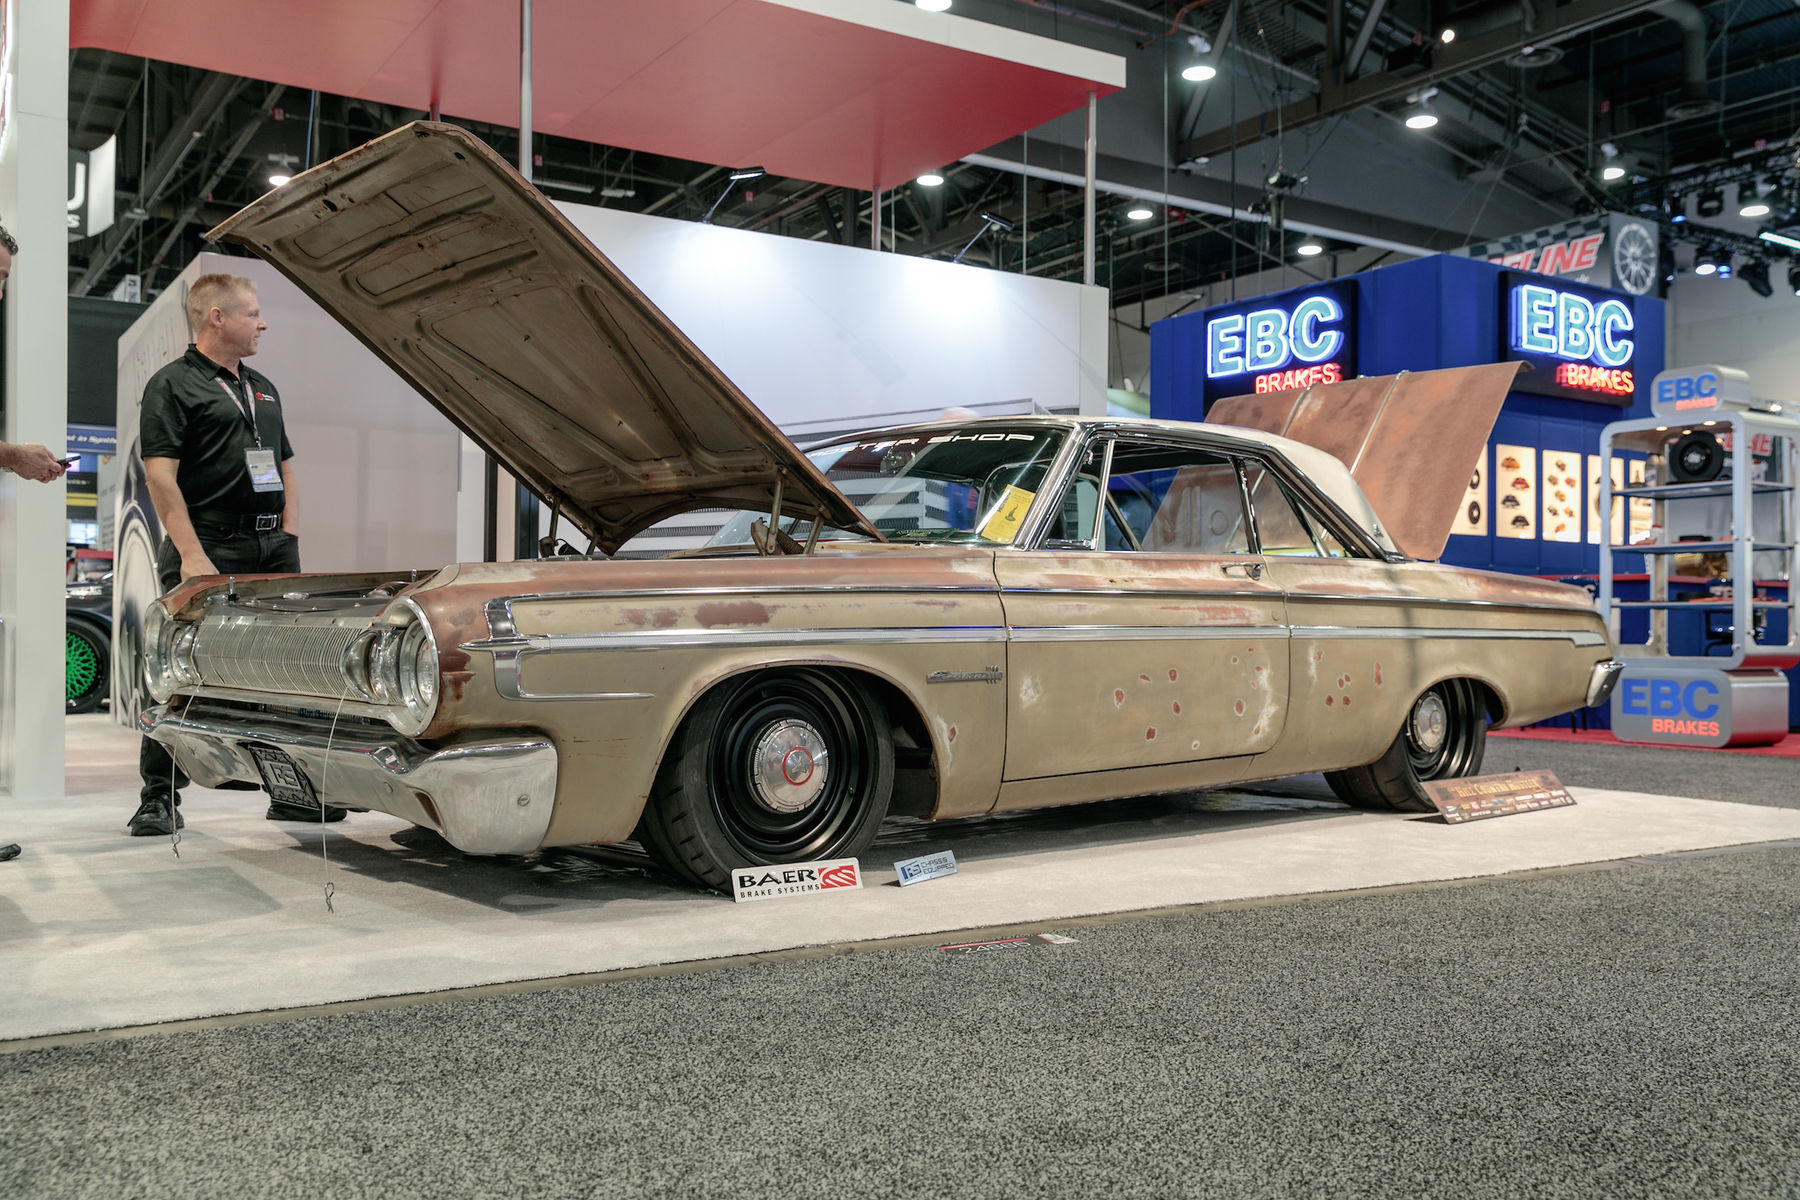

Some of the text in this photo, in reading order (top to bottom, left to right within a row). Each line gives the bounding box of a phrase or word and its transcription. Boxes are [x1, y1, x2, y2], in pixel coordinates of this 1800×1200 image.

[1206, 295, 1343, 379] EBC
[1513, 284, 1634, 367] EBC
[1255, 362, 1342, 395] BRAKES
[1561, 362, 1635, 394] BRAKES
[1658, 373, 1717, 403] EBC
[927, 433, 1036, 444] SHOP
[1621, 678, 1719, 720] EBC
[1651, 718, 1720, 737] BRAKES
[738, 869, 818, 888] BAER
[740, 883, 820, 899] BRAKE SYSTEMS
